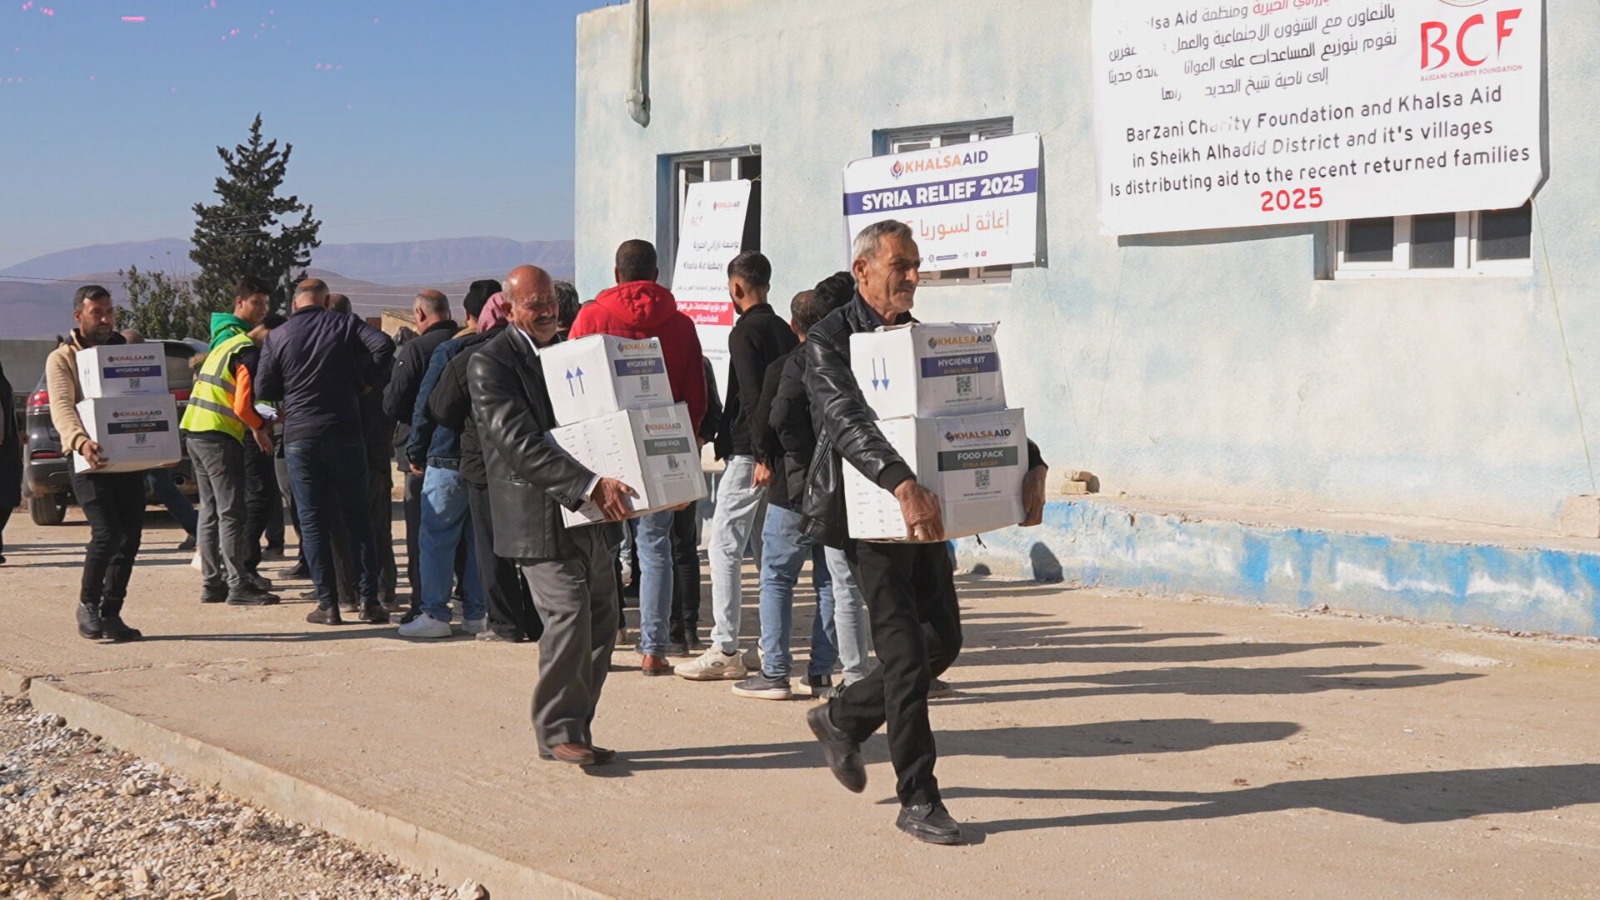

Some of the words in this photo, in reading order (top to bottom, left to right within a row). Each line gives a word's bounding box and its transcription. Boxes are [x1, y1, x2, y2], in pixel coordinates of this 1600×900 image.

[1175, 10, 1198, 27] Aid
[1202, 4, 1248, 21] ومنظمة
[1347, 3, 1395, 27] بالتعاون
[1213, 23, 1270, 47] الاجتماعية
[1274, 15, 1318, 38] الشؤون
[1321, 16, 1342, 35] مع
[1320, 34, 1358, 61] بتوزيع
[1363, 28, 1397, 52] نقوم
[1420, 8, 1523, 71] BCF
[1220, 53, 1245, 70] على
[1249, 42, 1316, 65] المساعدات
[1274, 70, 1302, 90] ناحية
[1306, 66, 1329, 86] إلى
[1449, 70, 1477, 79] CHARITY
[1479, 64, 1523, 75] FOUNDATION
[1205, 78, 1242, 98] الحديد
[1244, 75, 1271, 96] شيخ
[1188, 115, 1251, 134] Charity
[1257, 106, 1354, 129] Foundation
[1361, 98, 1393, 117] and
[1399, 91, 1463, 112] Khalsa
[1470, 85, 1502, 105] Aid
[1133, 153, 1145, 169] in
[1150, 146, 1200, 166] Sheikh
[1206, 140, 1267, 161] Alhadid
[1272, 131, 1340, 155] District
[1347, 128, 1377, 147] and
[1383, 125, 1414, 143] it's
[1420, 119, 1494, 140] villages
[905, 150, 989, 173] KHALSAAID
[1110, 182, 1121, 197] Is
[1125, 173, 1213, 196] distributing
[1217, 169, 1239, 187] aid
[1244, 168, 1260, 184] to
[1266, 166, 1293, 182] the
[1299, 159, 1357, 181] recent
[1364, 151, 1448, 174] returned
[1454, 144, 1531, 167] families
[862, 190, 913, 211] SYRIA
[916, 181, 977, 204] RELIEF
[980, 174, 1025, 196] 2025
[1260, 187, 1324, 212] 2025
[920, 213, 970, 240] لسوريا
[975, 209, 1010, 234] إغاثة
[937, 357, 972, 367] HYGIENE
[973, 355, 986, 364] KIT
[954, 428, 1011, 440] KHALSAAID
[957, 452, 981, 461] FOOD
[982, 450, 1004, 459] PACK
